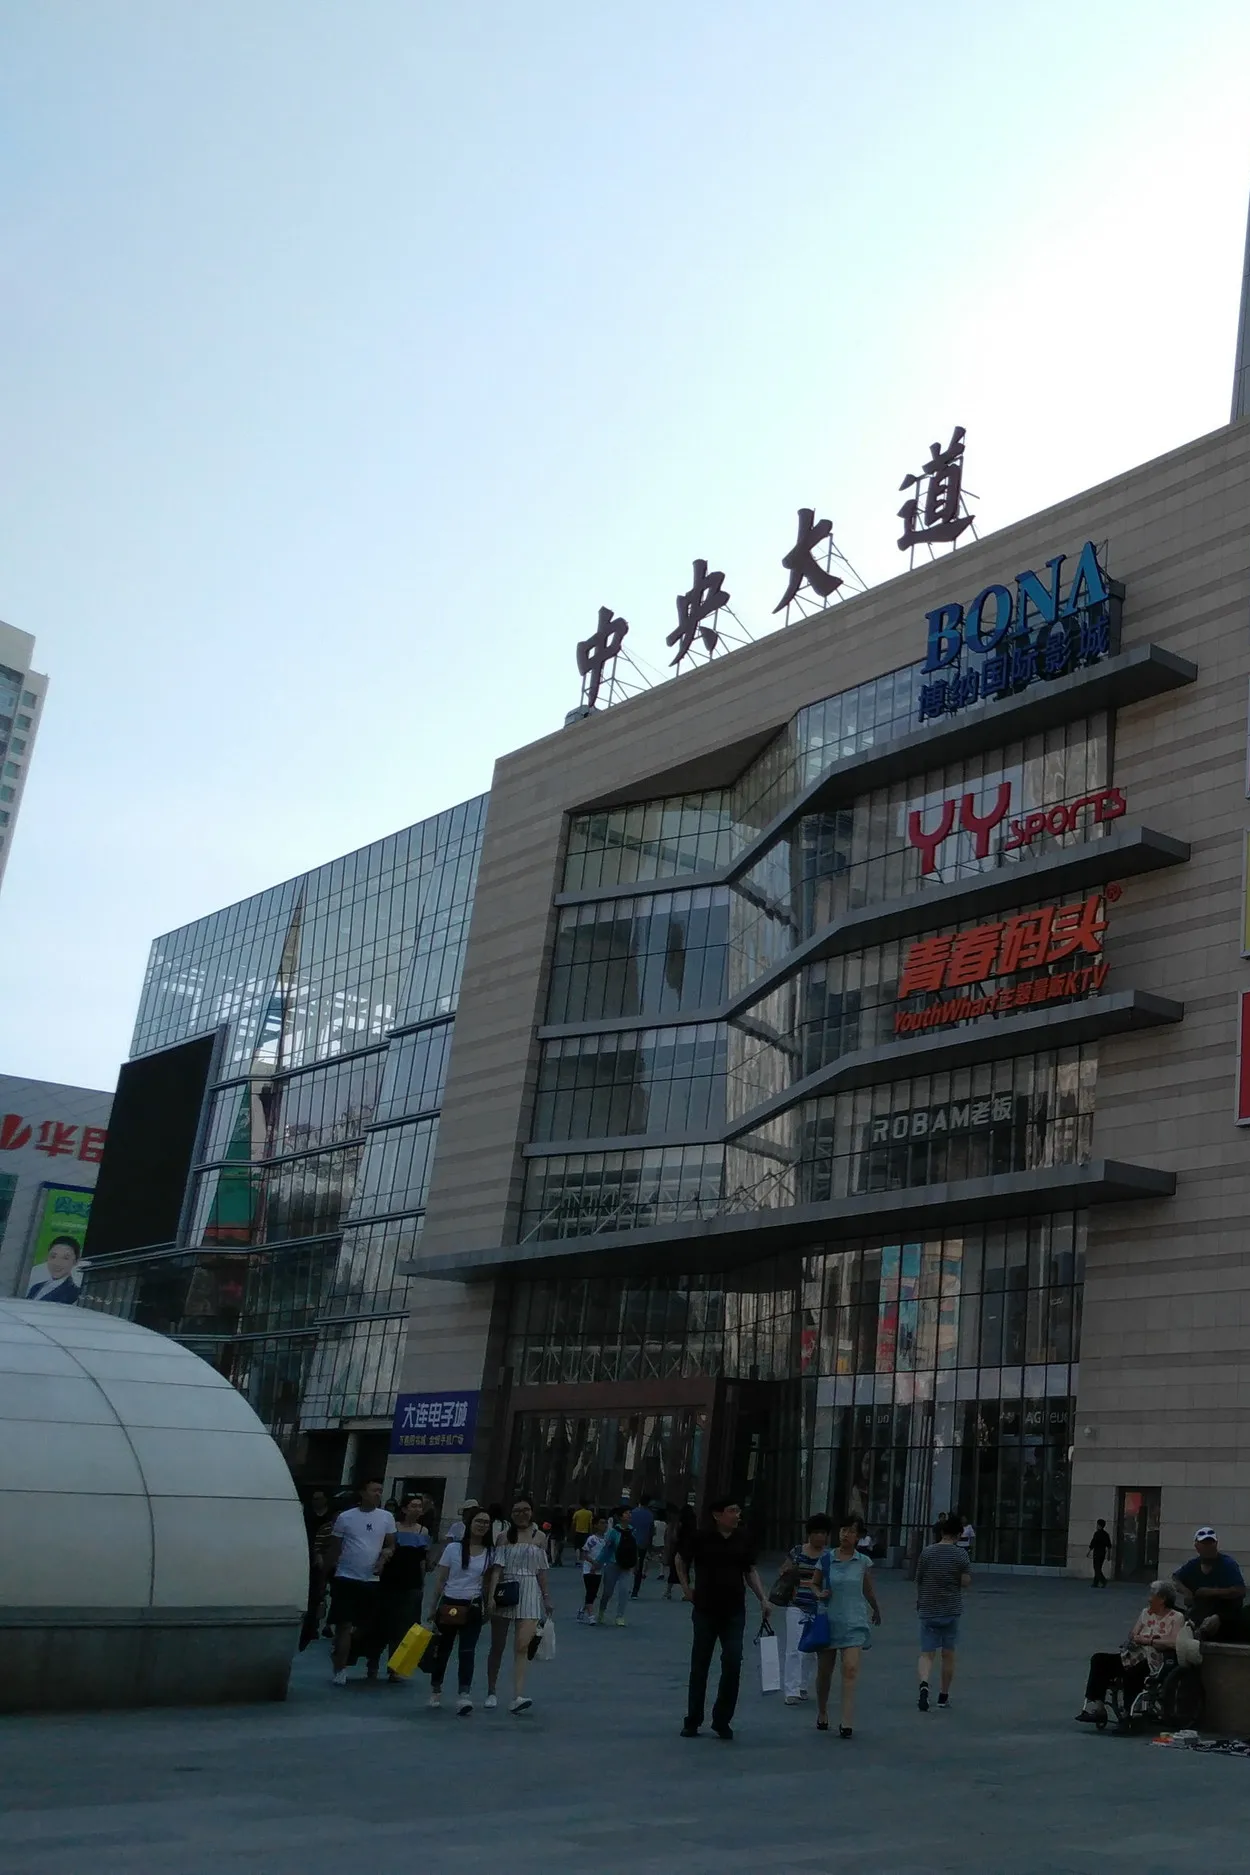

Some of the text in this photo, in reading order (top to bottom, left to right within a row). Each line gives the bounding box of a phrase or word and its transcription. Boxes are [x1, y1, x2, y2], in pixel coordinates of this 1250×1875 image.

[577, 426, 975, 708] 中央大道
[920, 541, 1110, 674] BONA
[909, 782, 1011, 875] YY
[898, 895, 1109, 999] 青春码头
[402, 1401, 468, 1428] 大连电子城
